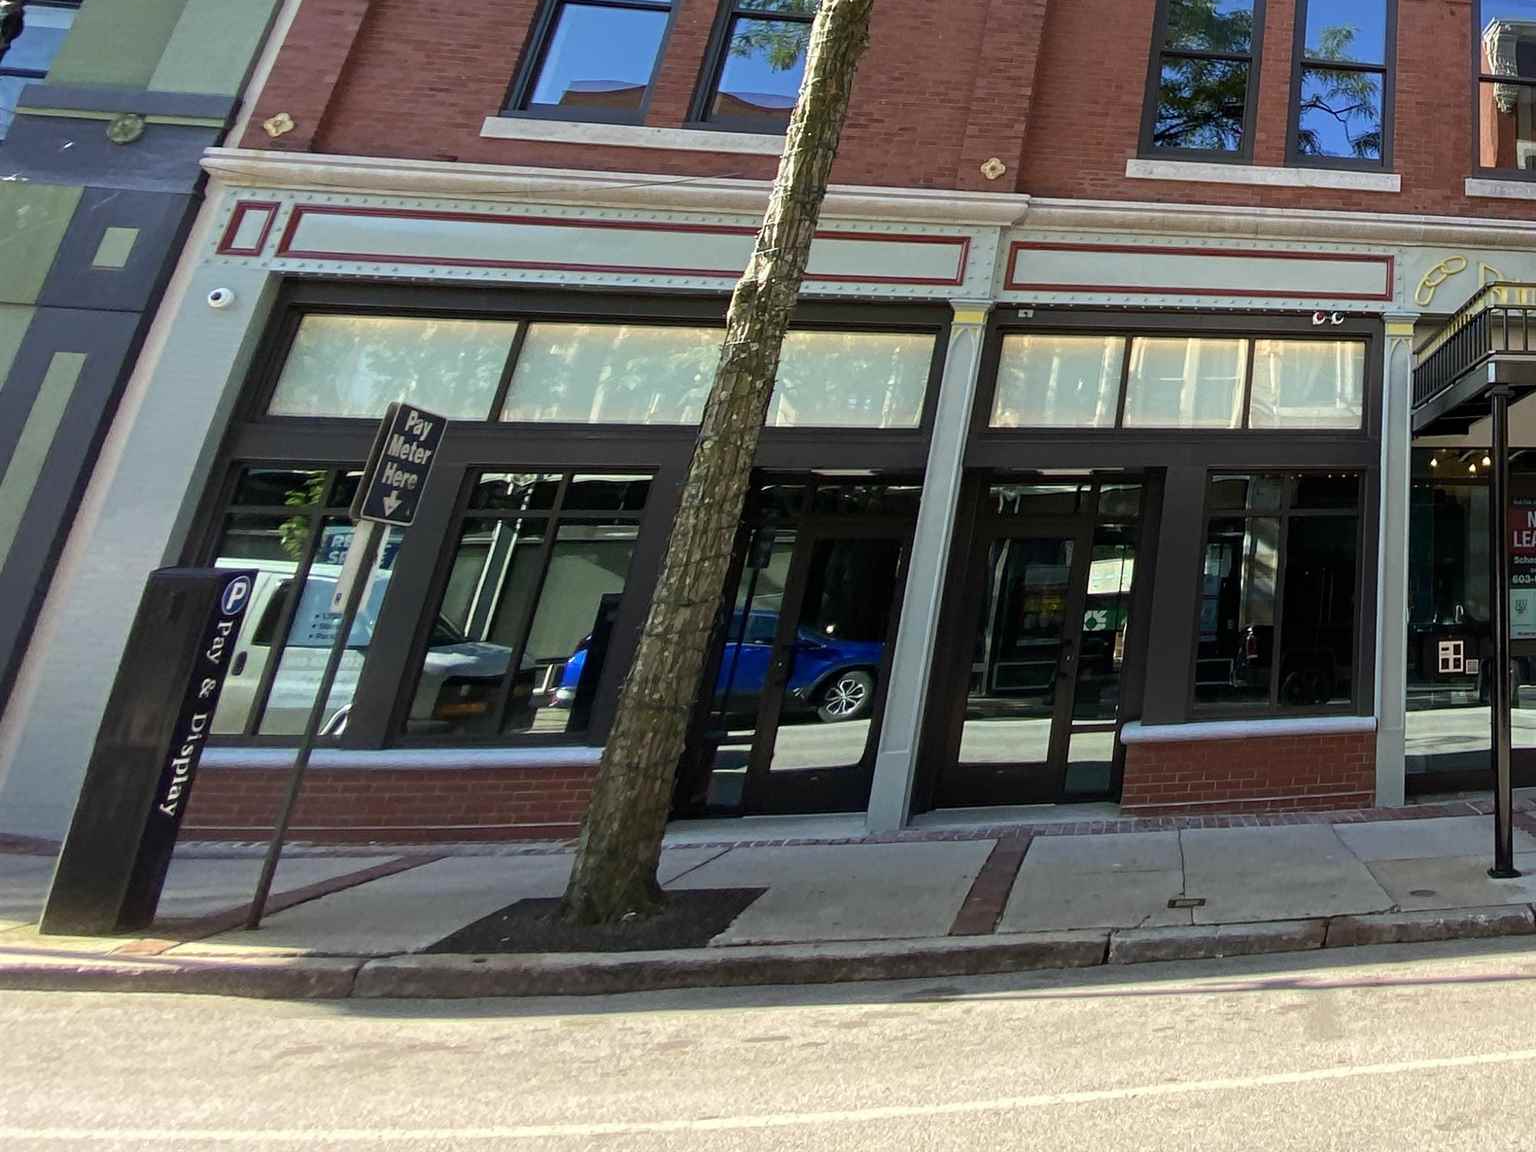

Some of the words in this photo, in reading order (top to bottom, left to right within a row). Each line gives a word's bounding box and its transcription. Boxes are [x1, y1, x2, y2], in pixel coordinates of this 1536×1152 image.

[404, 409, 433, 441] Pay
[387, 433, 432, 465] Meter
[381, 461, 419, 490] Here
[206, 619, 234, 664] Pay
[199, 678, 217, 699] &
[159, 713, 208, 817] Display
